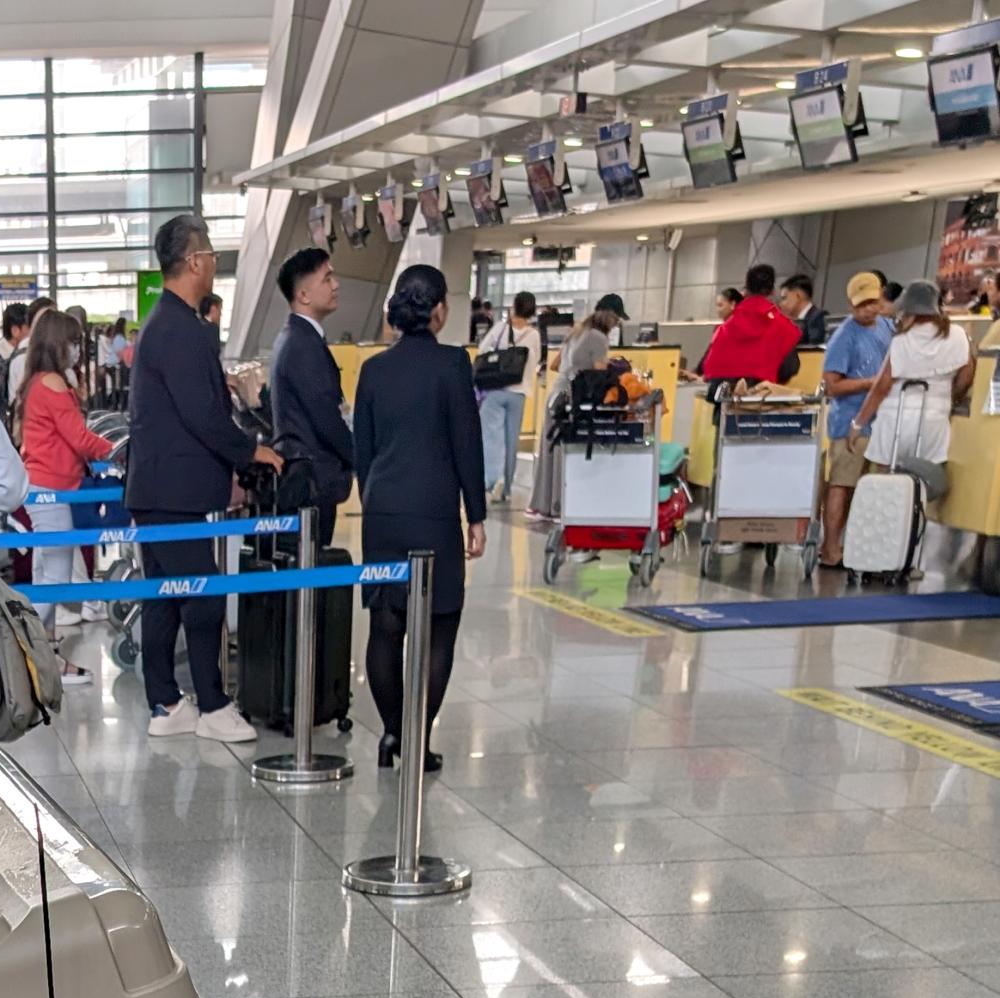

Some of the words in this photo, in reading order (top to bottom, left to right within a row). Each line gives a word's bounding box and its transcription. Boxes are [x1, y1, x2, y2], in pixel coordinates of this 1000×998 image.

[35, 493, 57, 504] ANA
[254, 517, 281, 531] ANA
[99, 530, 124, 542] ANA
[358, 566, 391, 581] ANA
[158, 580, 191, 595] ANA
